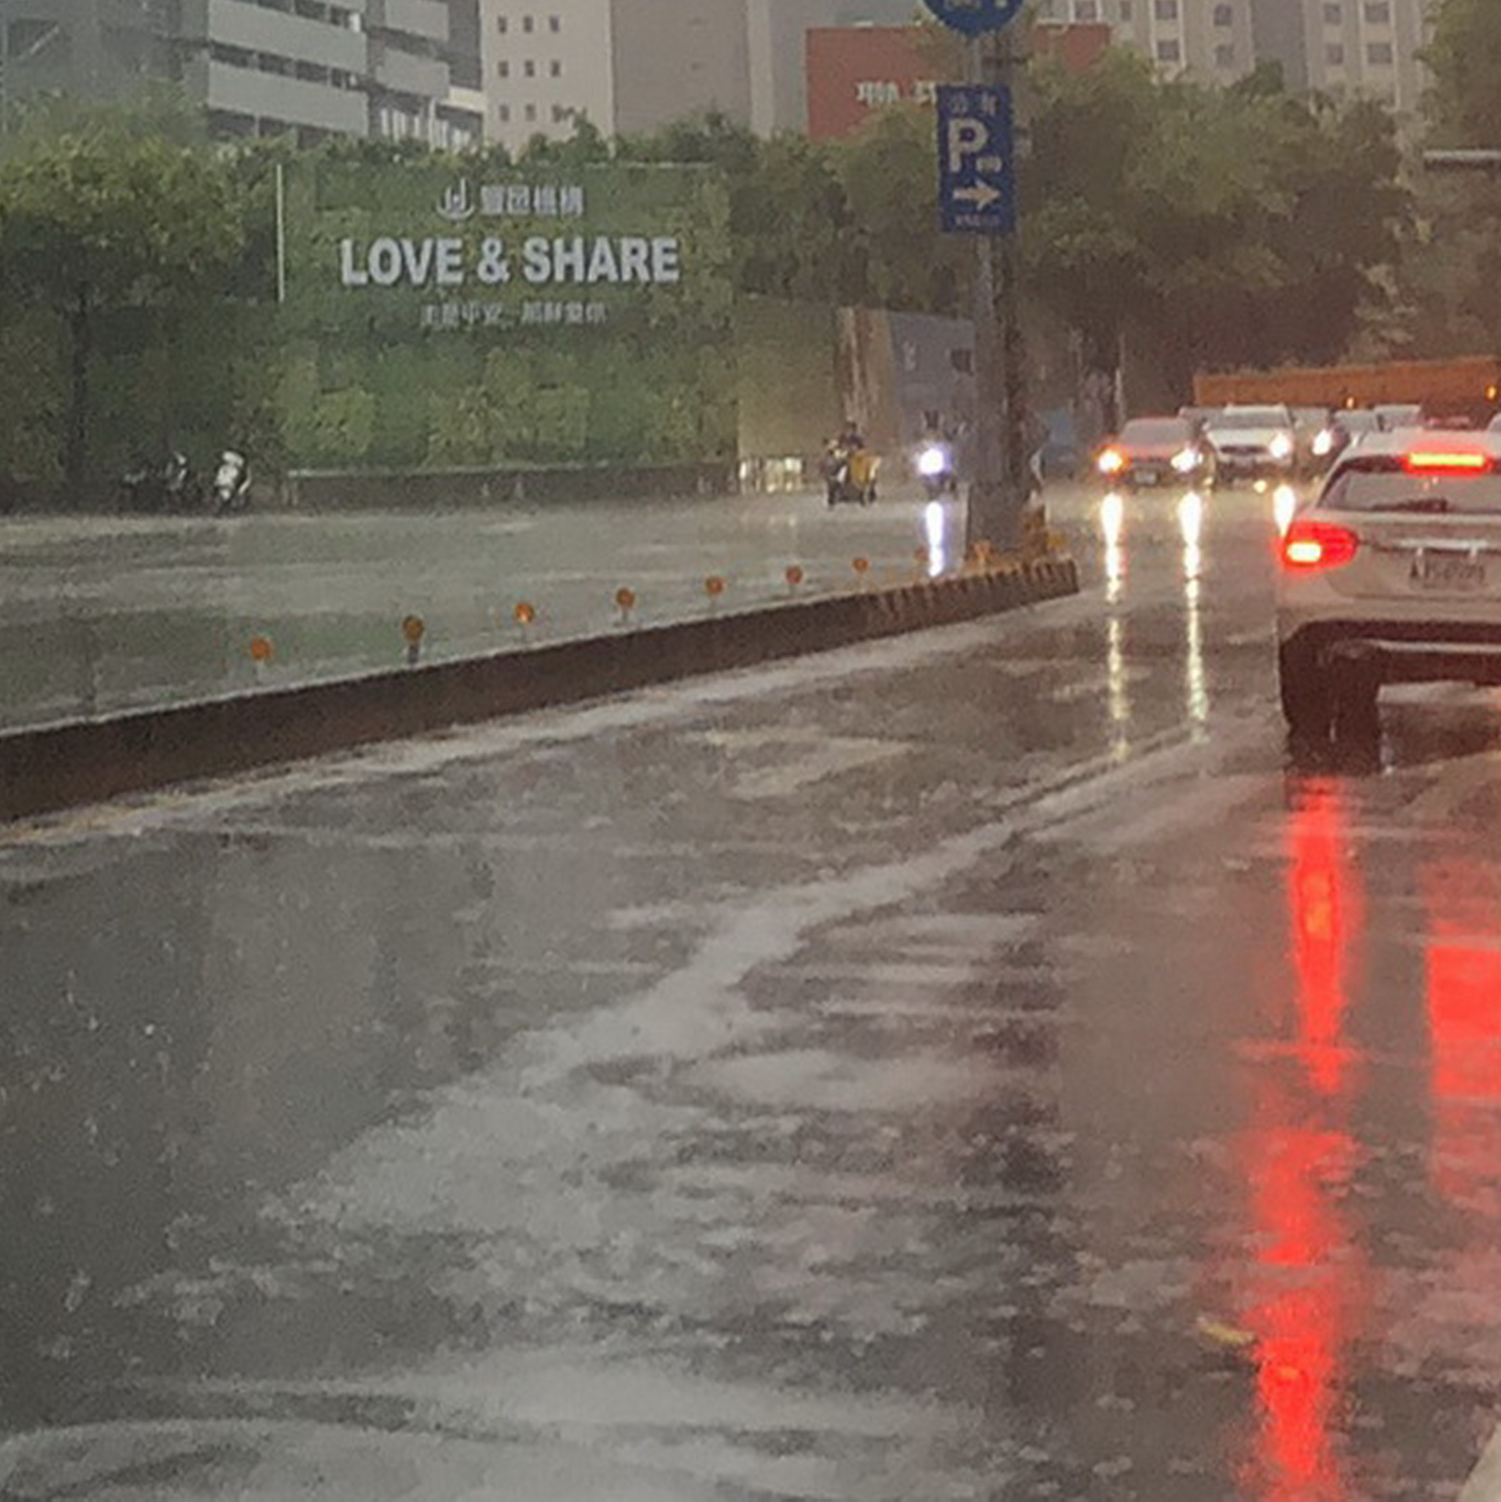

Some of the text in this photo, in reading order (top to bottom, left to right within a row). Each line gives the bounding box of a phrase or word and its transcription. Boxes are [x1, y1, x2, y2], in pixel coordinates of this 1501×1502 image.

[949, 117, 988, 172] P
[340, 235, 680, 286] LOVE & SHARE
